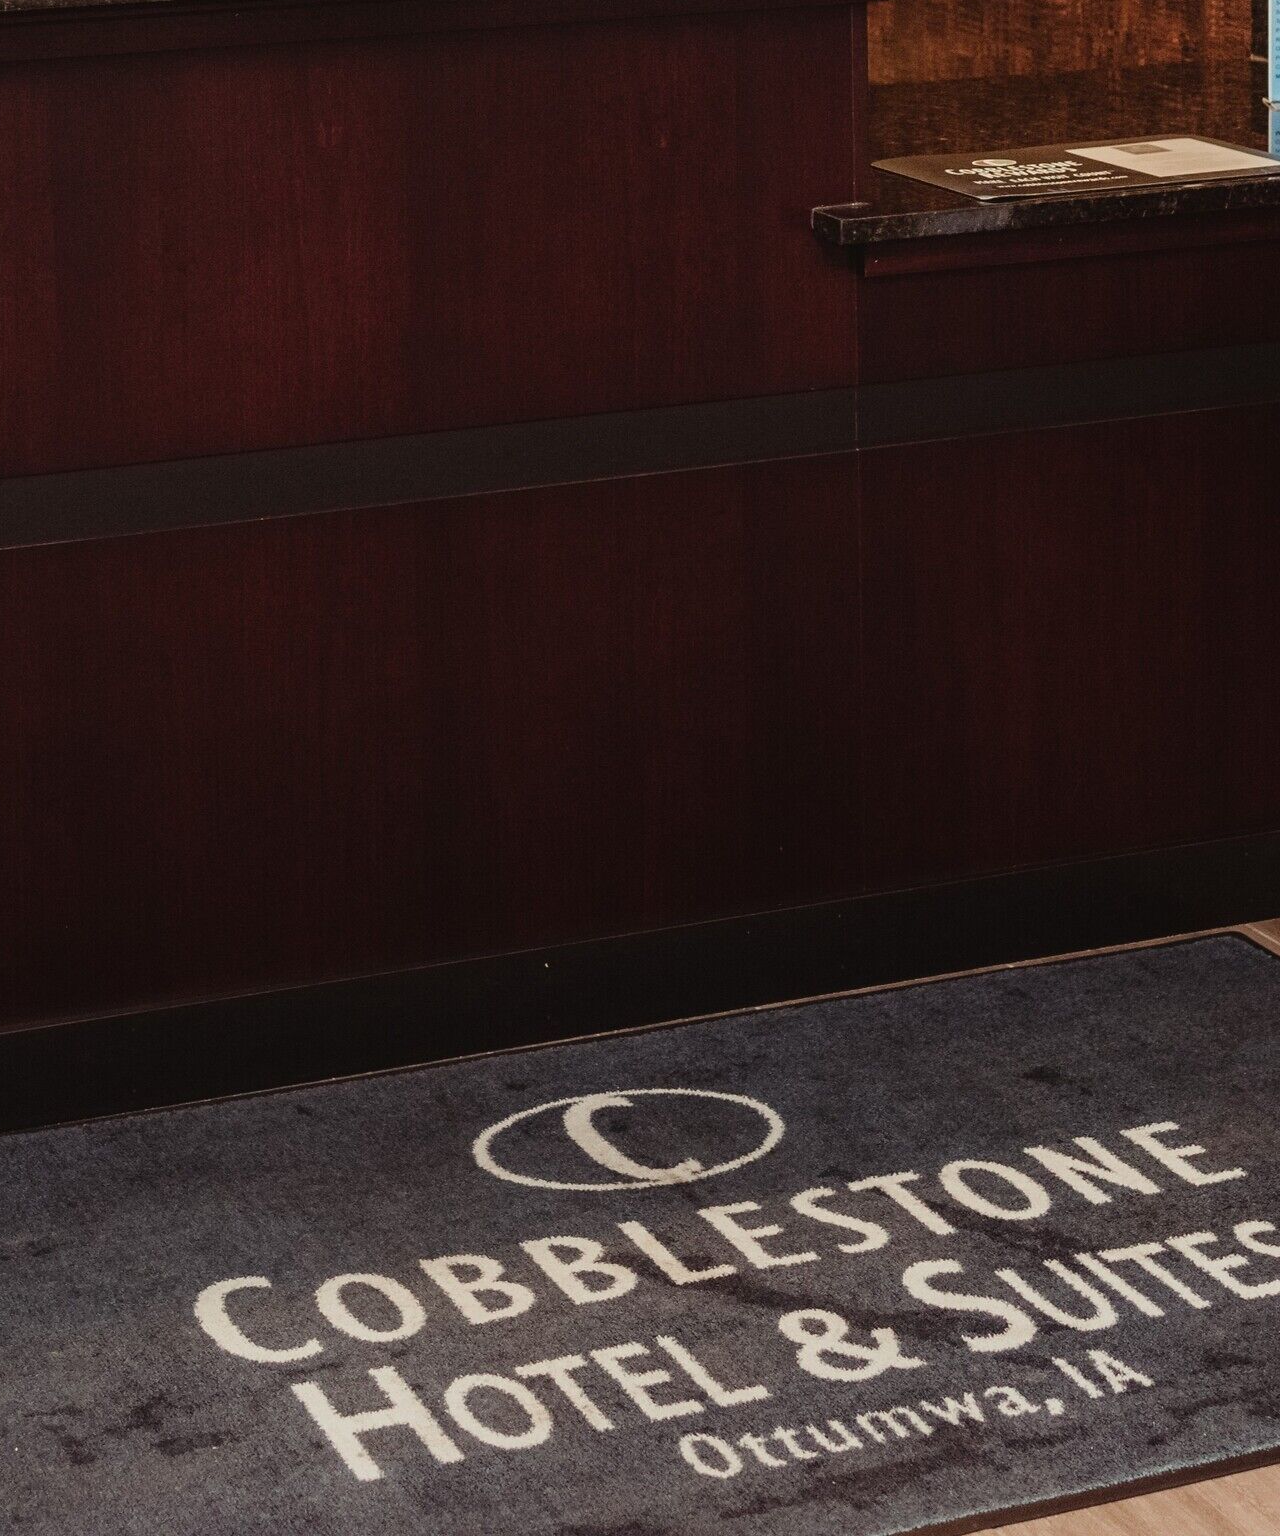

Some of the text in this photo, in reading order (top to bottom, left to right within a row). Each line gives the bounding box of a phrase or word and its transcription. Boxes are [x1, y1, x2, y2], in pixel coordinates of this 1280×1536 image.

[193, 1120, 1247, 1364] COBBLESTONE
[290, 1334, 773, 1483] HOTEL
[778, 1306, 928, 1383] &
[678, 1348, 1155, 1480] Ottumwa, IA
